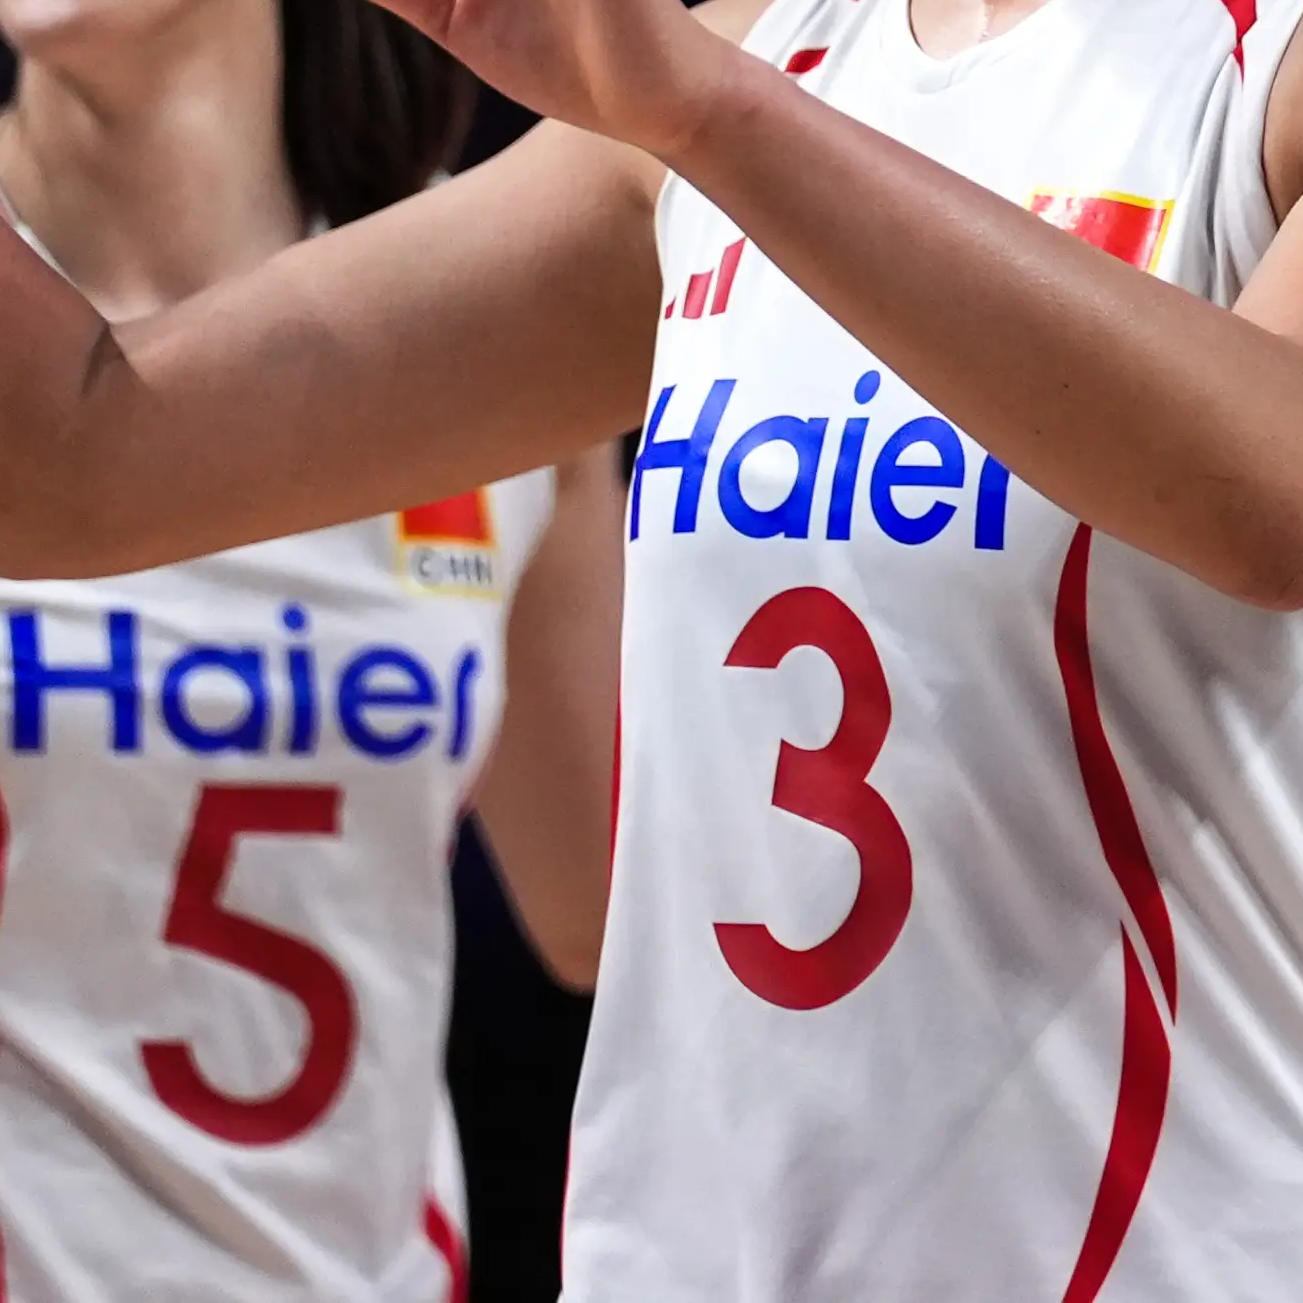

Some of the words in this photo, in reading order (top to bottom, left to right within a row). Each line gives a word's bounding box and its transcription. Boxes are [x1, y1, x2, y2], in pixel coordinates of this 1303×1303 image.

[8, 603, 483, 760] Haier
[712, 586, 913, 1010] 3
[138, 785, 359, 1146] 5
